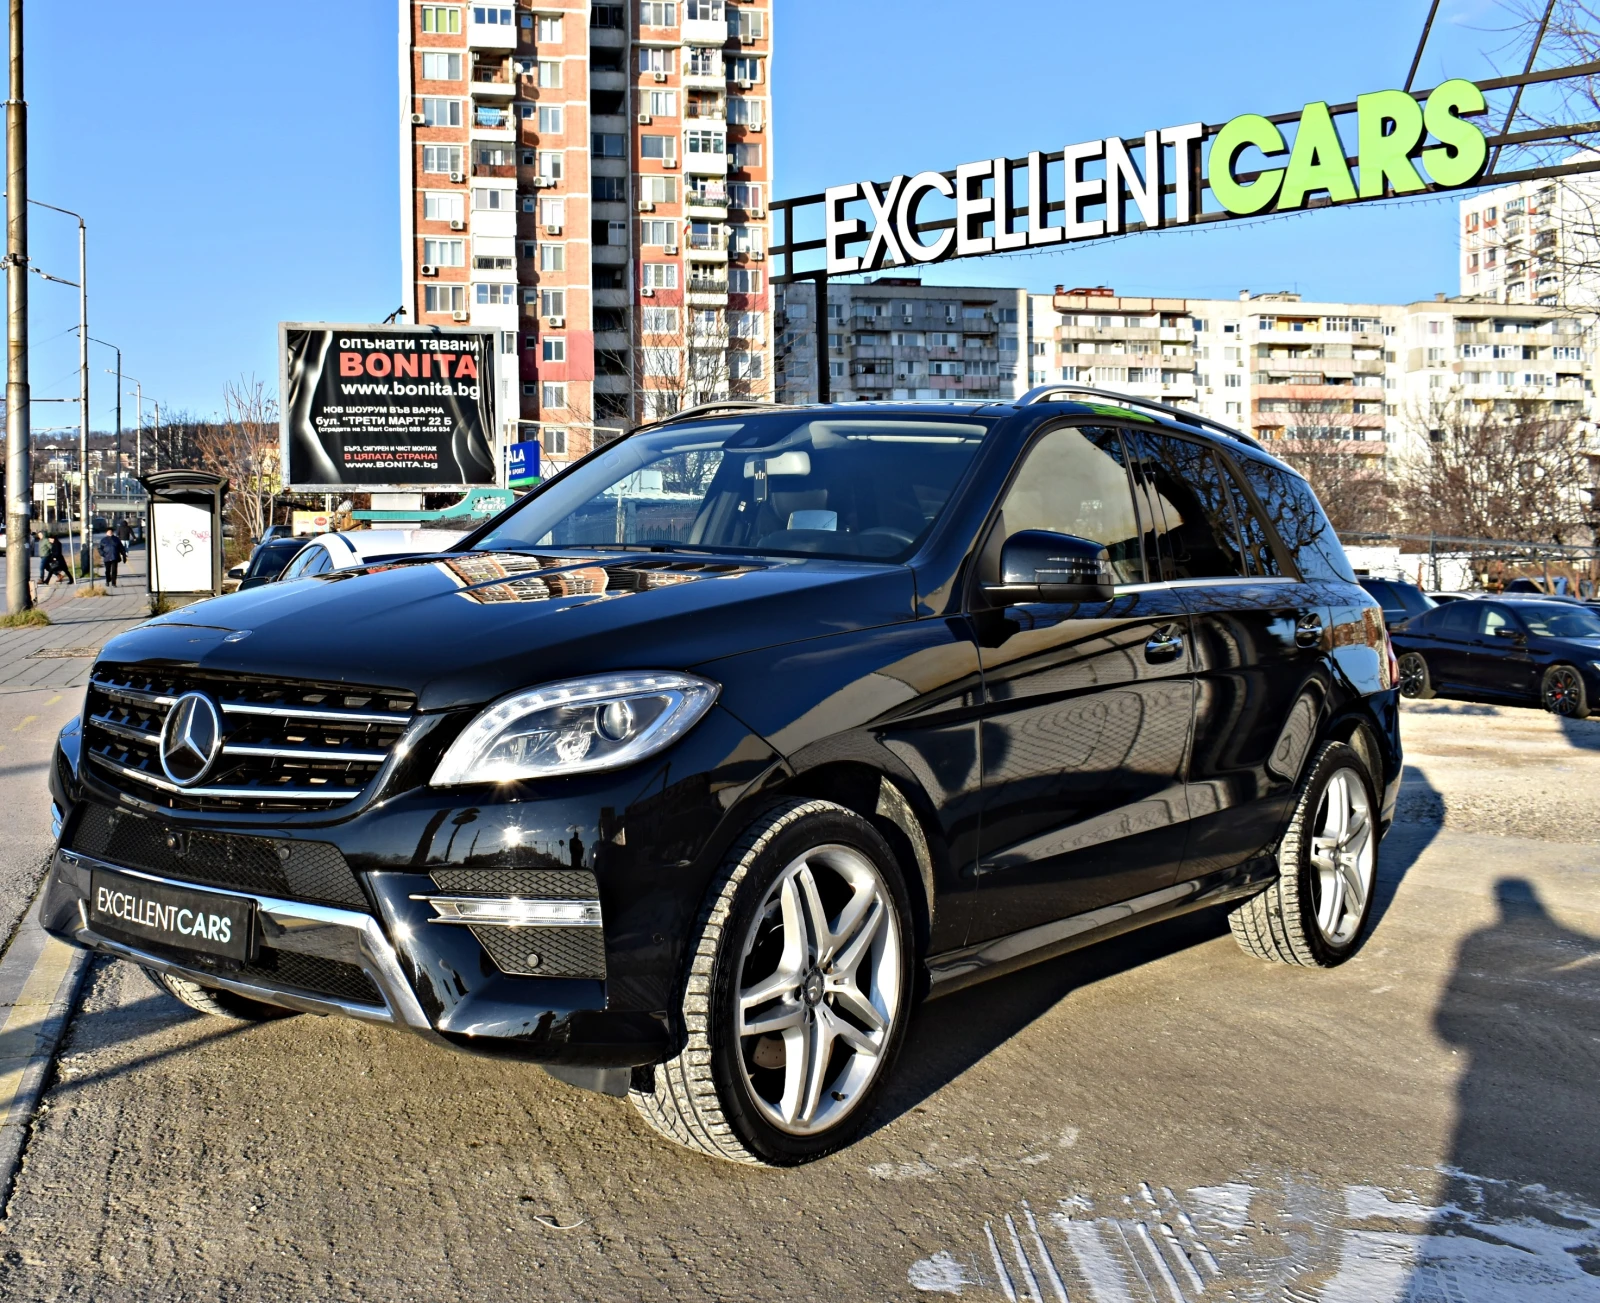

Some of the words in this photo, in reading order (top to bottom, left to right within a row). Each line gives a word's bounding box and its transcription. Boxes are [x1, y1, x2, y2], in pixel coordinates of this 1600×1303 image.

[339, 337, 415, 350] опънати
[420, 338, 479, 351] тавани
[339, 352, 479, 378] BONITA
[341, 381, 480, 400] www.bonita.bg
[323, 406, 344, 414] НОВ
[345, 406, 387, 414] ШОУРУМ
[389, 406, 410, 414] ВЪВ
[412, 406, 444, 414] ВАРНА
[315, 416, 340, 427] бул.
[342, 416, 385, 425] “ТРЕТИ
[428, 417, 441, 425] 22
[444, 417, 452, 425] Б
[353, 453, 394, 461] ЦЯЛАТА
[345, 461, 438, 469] www.BONITA.bg
[754, 469, 766, 480] VIP
